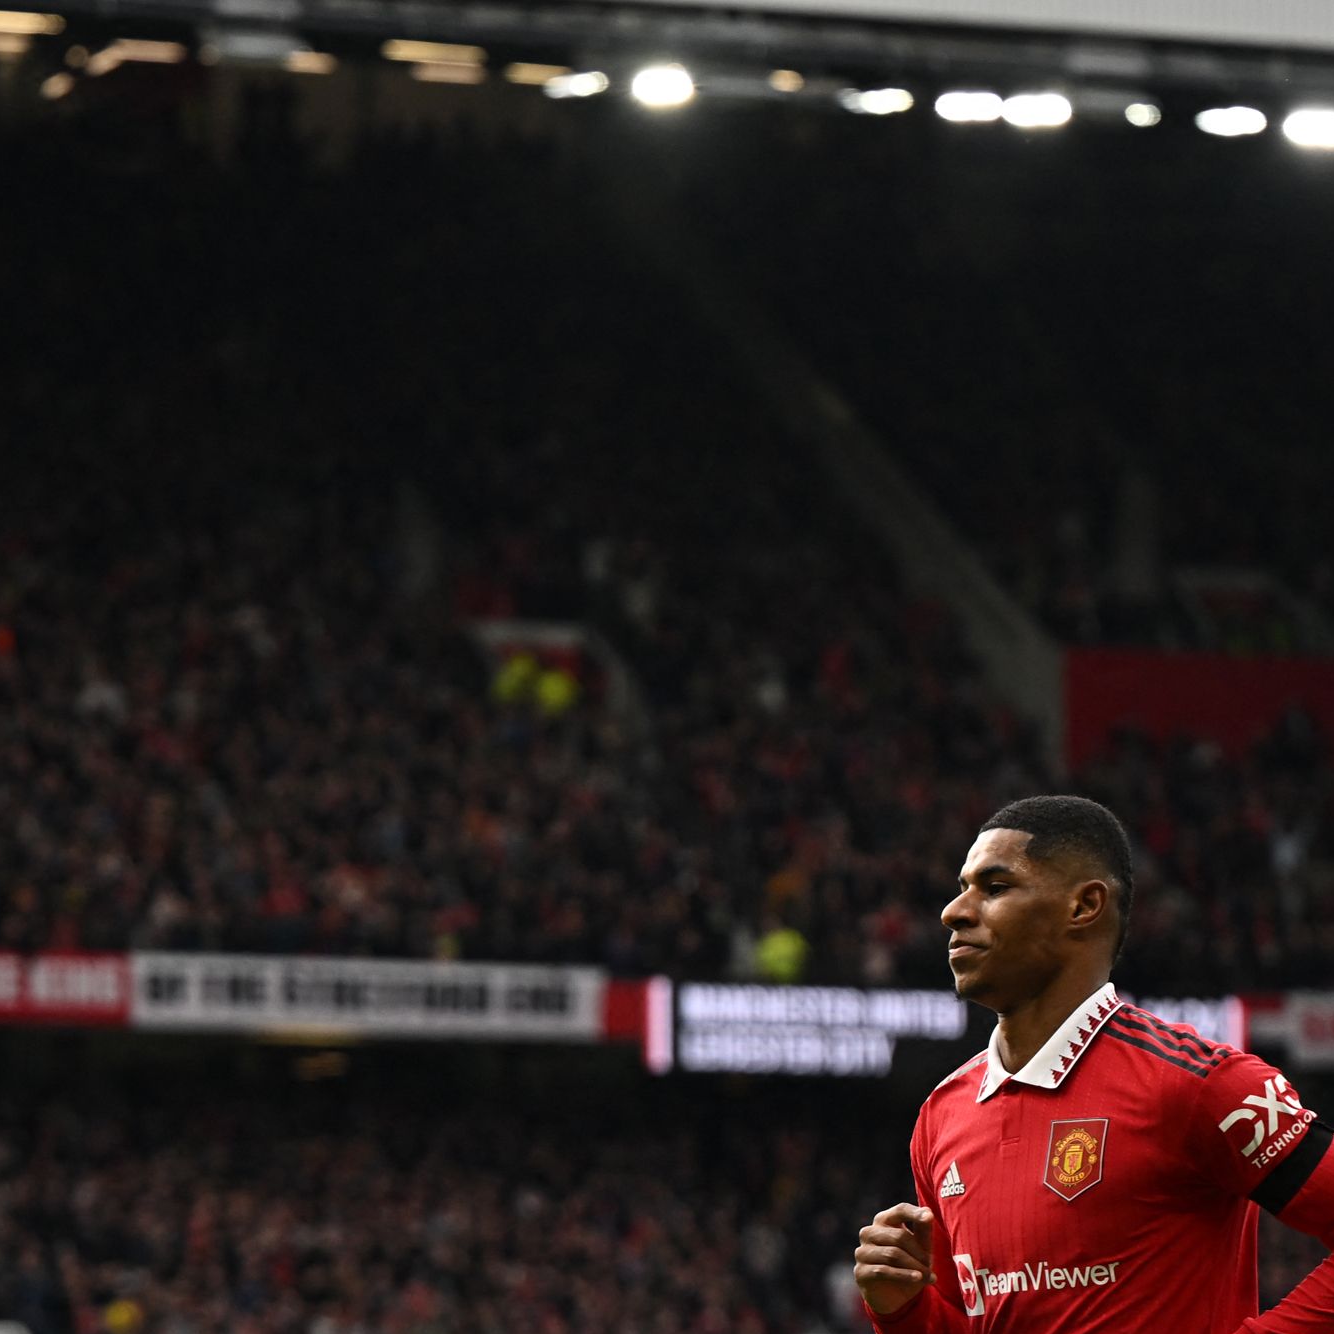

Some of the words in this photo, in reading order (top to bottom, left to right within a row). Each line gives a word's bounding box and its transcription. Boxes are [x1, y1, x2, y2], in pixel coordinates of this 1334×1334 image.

[1057, 1131, 1095, 1153] MANCHESTER
[1251, 1109, 1317, 1169] TECHNOLO
[1058, 1171, 1085, 1182] UNITED
[940, 1182, 965, 1198] adidas
[974, 1261, 1120, 1296] TeamViewer
